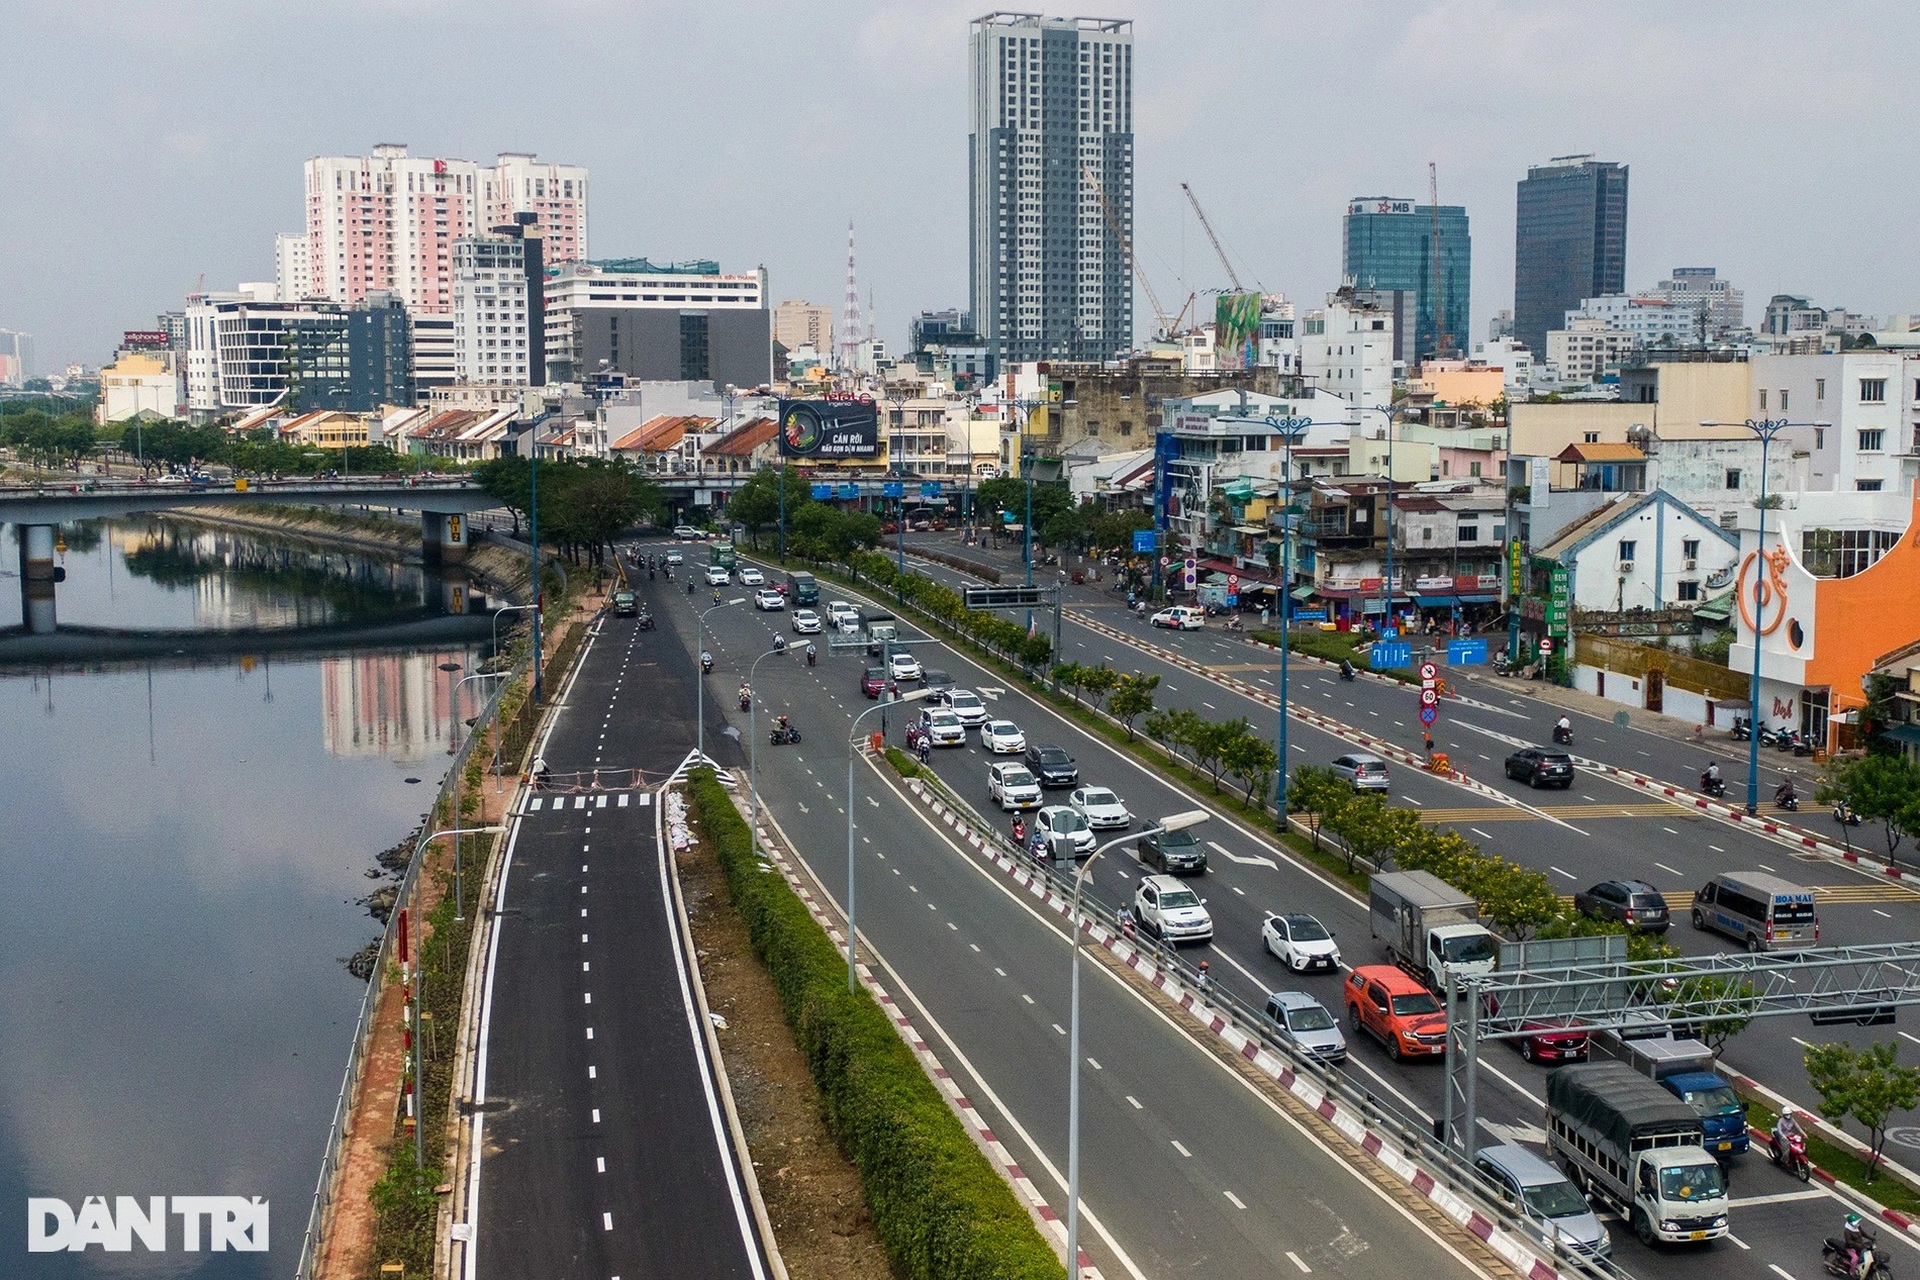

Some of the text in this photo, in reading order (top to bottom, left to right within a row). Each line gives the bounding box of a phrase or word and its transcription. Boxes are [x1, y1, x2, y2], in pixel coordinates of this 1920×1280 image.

[1392, 202, 1410, 213] MB
[832, 432, 863, 444] CÁN RỜI
[1424, 692, 1433, 701] 60
[1775, 894, 1812, 903] HOA MAI
